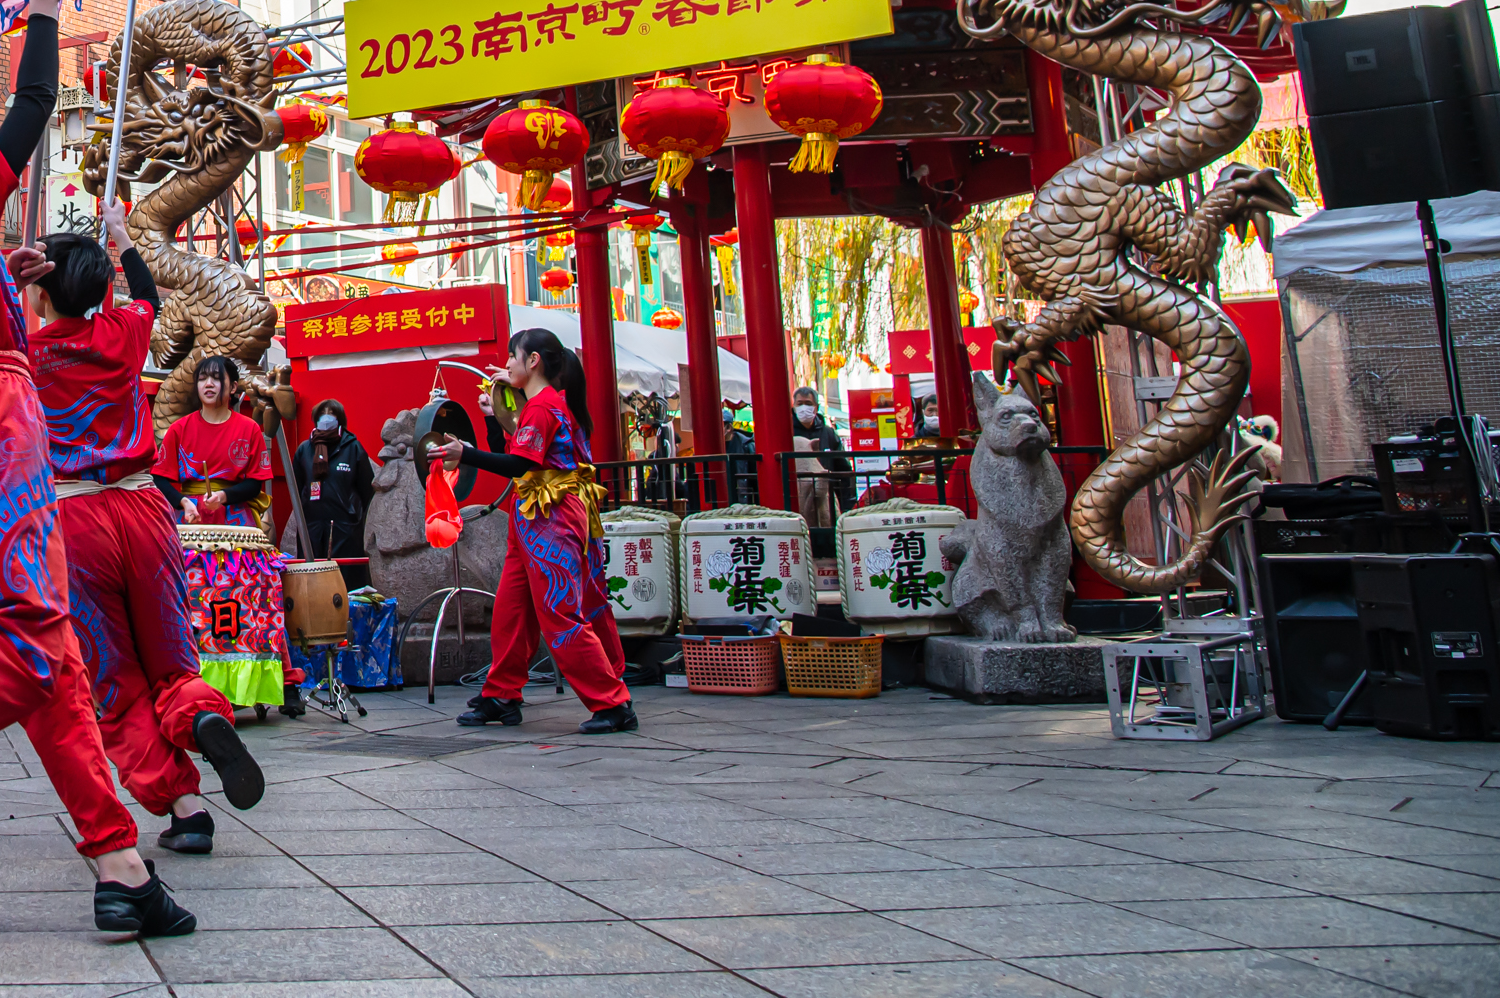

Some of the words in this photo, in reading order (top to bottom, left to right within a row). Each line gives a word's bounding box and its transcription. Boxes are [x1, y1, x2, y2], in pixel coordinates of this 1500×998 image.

[57, 201, 86, 229] 北
[302, 303, 475, 339] 祭壇参拝受付中
[624, 542, 639, 577] 秀天涯
[729, 536, 768, 615] 菊正宗
[888, 530, 932, 610] 菊正宗
